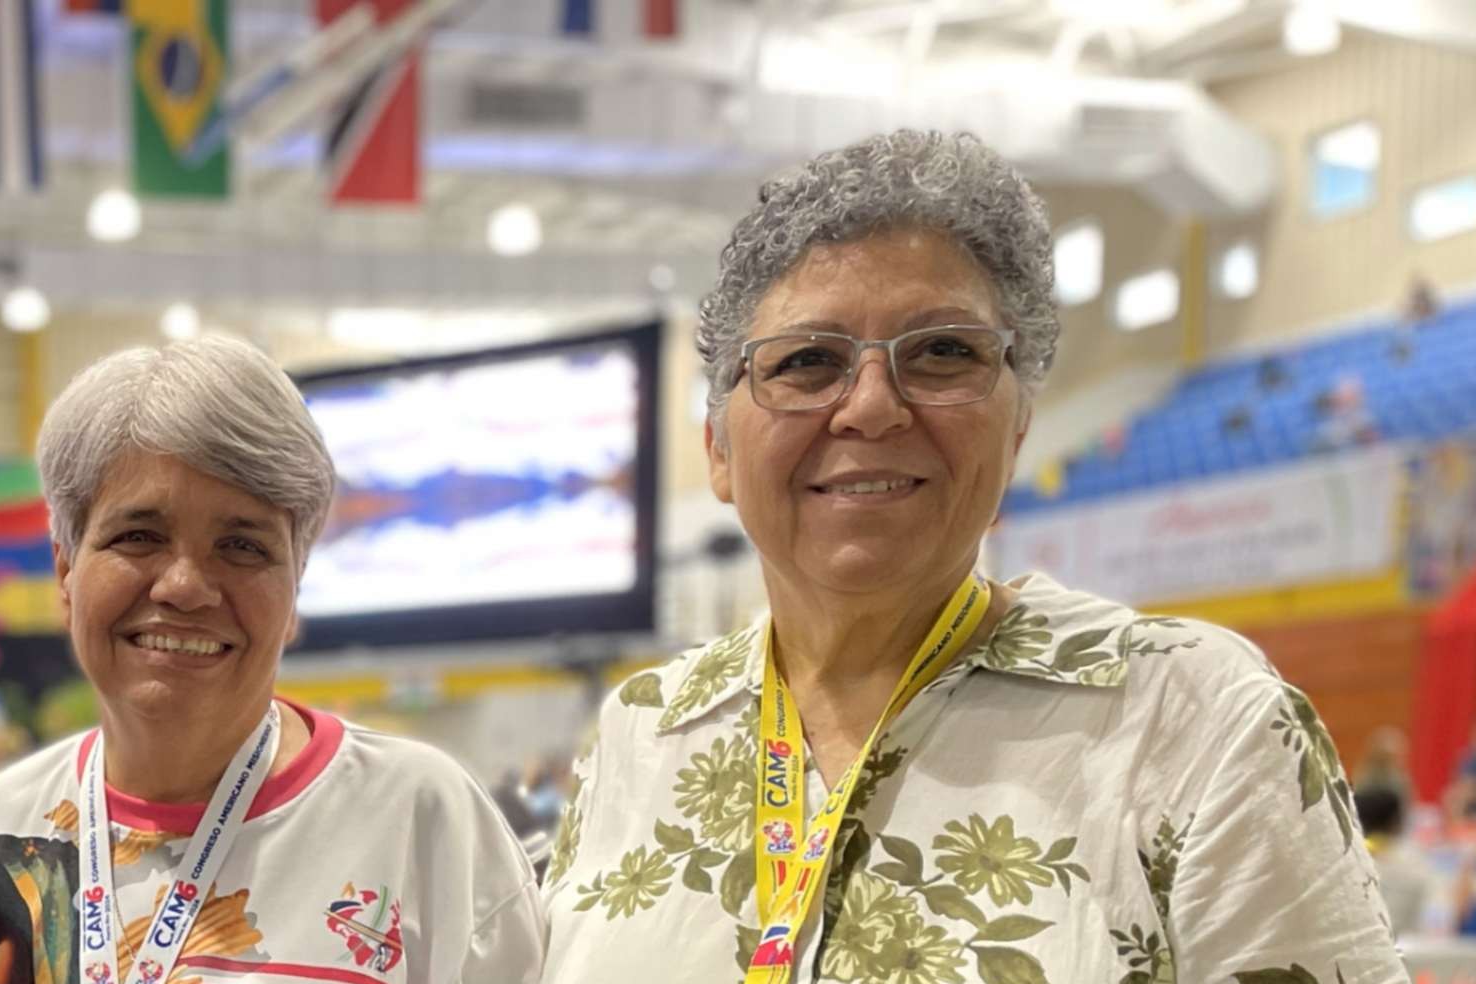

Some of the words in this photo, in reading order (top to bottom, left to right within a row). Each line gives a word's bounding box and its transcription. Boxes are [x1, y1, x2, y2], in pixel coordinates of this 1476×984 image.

[191, 827, 221, 880] CONGRESO
[218, 771, 251, 826] AMERICANO
[246, 724, 273, 771] MISIONERO
[766, 738, 792, 808] CAM6
[87, 831, 99, 884] CONGRESO
[85, 886, 106, 950] CAM6
[153, 880, 198, 948] CAM6
